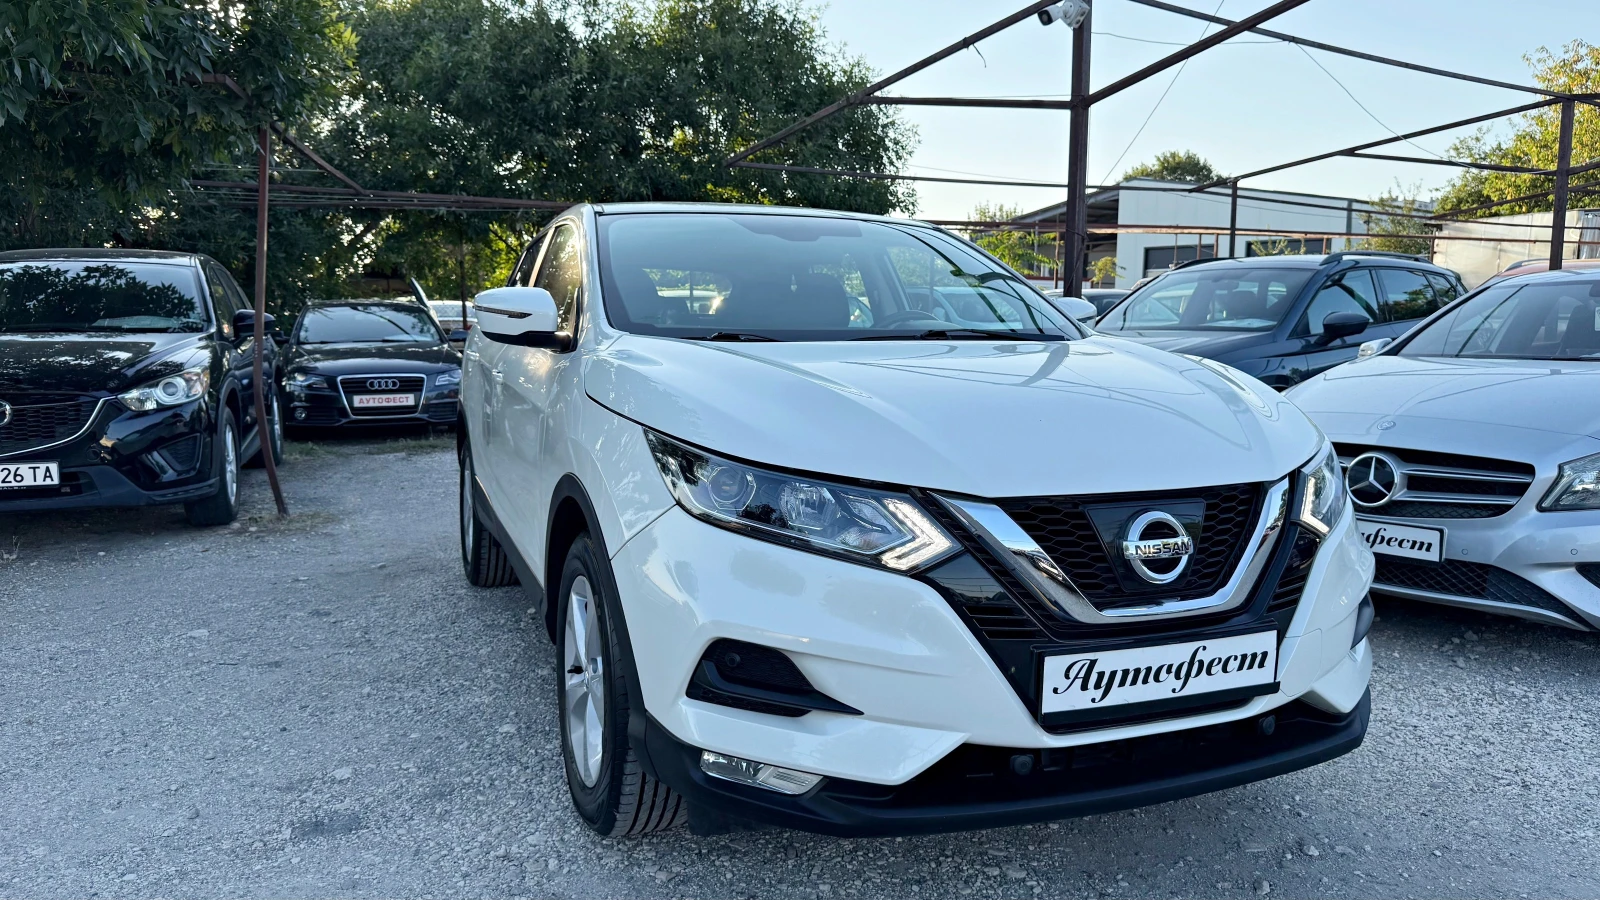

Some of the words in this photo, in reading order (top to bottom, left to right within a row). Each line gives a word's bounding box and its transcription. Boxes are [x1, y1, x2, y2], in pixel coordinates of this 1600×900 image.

[358, 396, 410, 404] АУТОФЕСТ
[1134, 539, 1190, 555] NISSAN
[1052, 645, 1269, 704] Аутофест
